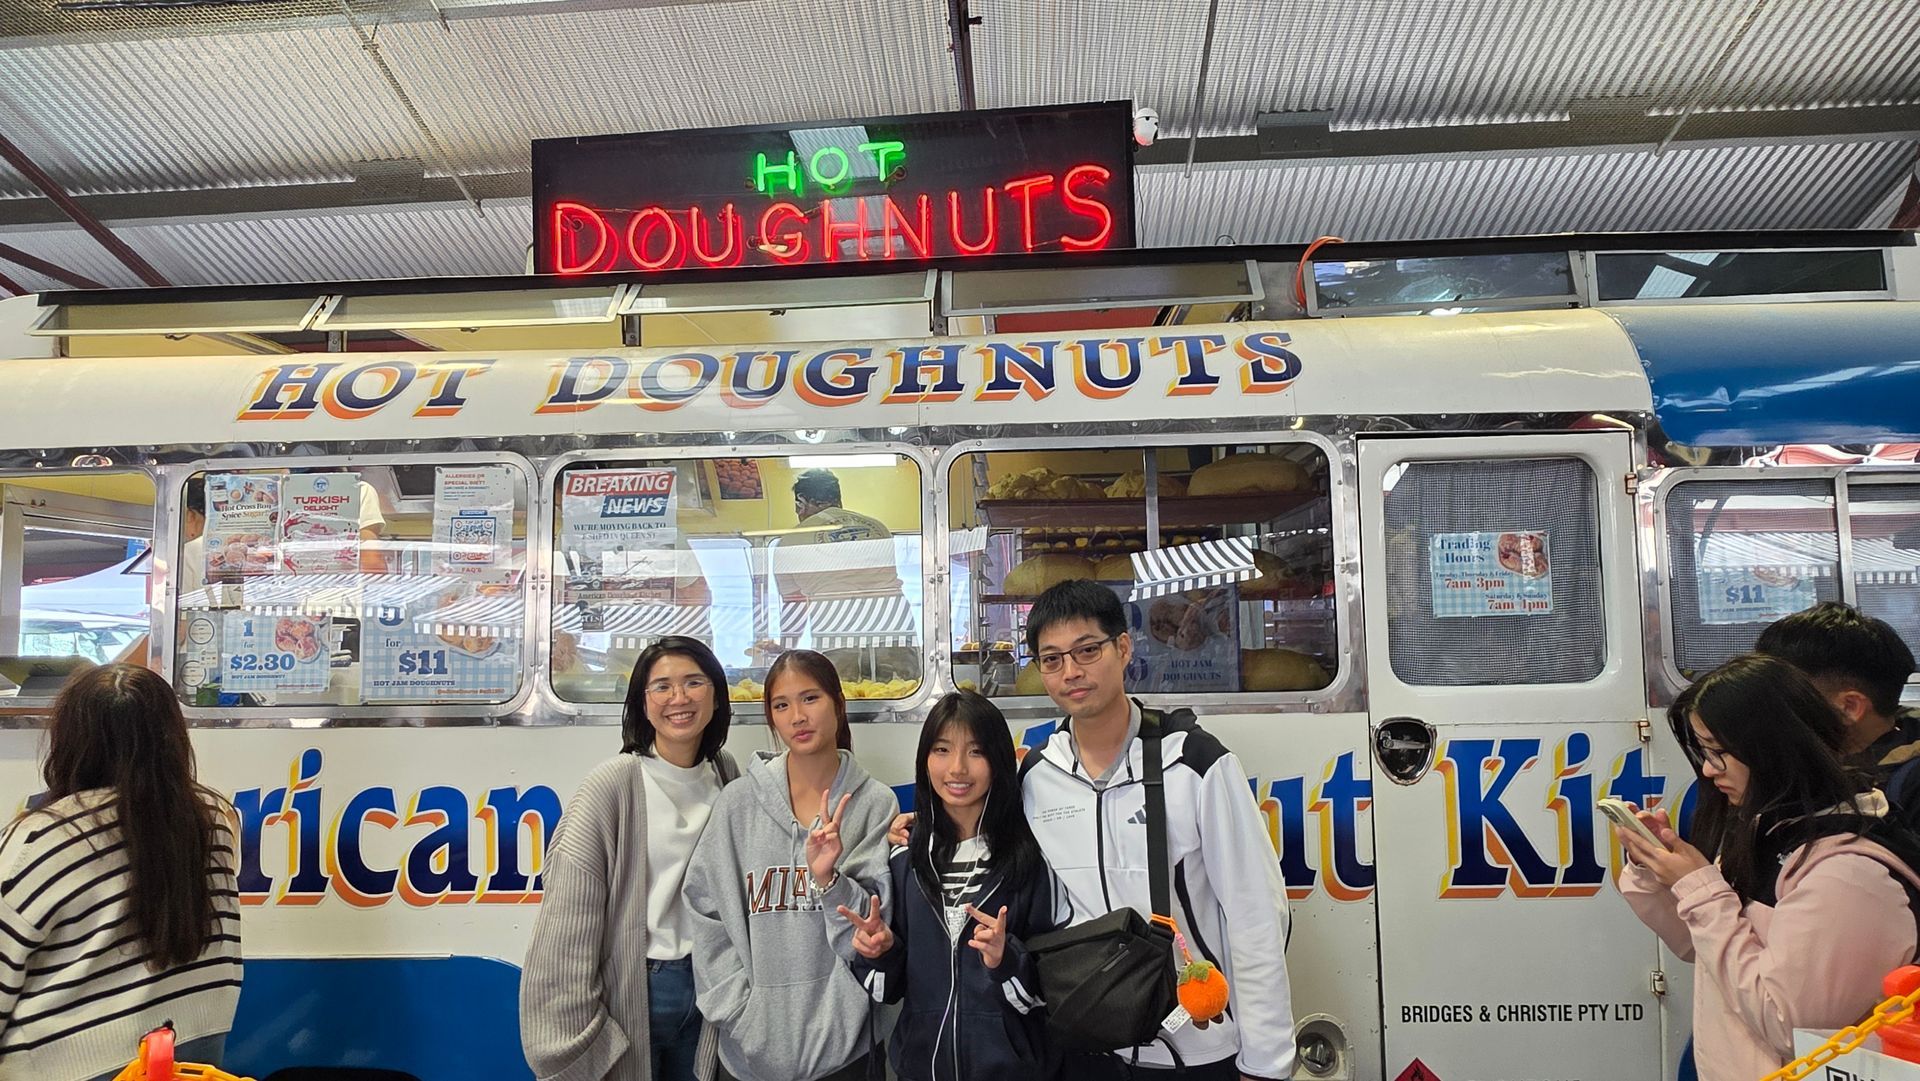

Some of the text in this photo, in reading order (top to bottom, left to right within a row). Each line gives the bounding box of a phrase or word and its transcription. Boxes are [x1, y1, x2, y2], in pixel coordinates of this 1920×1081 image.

[757, 141, 905, 192] HOT
[555, 165, 1112, 274] DOUGHNUTS
[236, 331, 1303, 422] HOT DOUGHNUTS
[570, 474, 670, 493] BREAKING
[221, 504, 235, 512] Hot
[293, 495, 350, 504] TURKISH
[606, 497, 664, 514] NEWS
[221, 512, 241, 521] Spice
[573, 523, 599, 531] WE'RE
[600, 523, 631, 531] MOVING
[631, 522, 653, 530] BACK
[1440, 538, 1491, 551] Trading
[1445, 553, 1485, 563] Hours
[1444, 577, 1505, 590] 7am 3pm
[1725, 584, 1766, 604] $11
[1487, 600, 1515, 610] 7am
[243, 619, 254, 637] 1
[385, 638, 401, 648] for
[230, 653, 296, 671] $2.30
[399, 650, 448, 675] $11
[1171, 658, 1213, 668] HOT JAM
[1163, 671, 1222, 681] DOUGHNUTS
[234, 748, 563, 908] rican
[1433, 731, 1700, 898] Kit
[745, 866, 824, 913] MIA
[1401, 1004, 1644, 1023] BRIDGES & CHRISTIE PTY LTD
